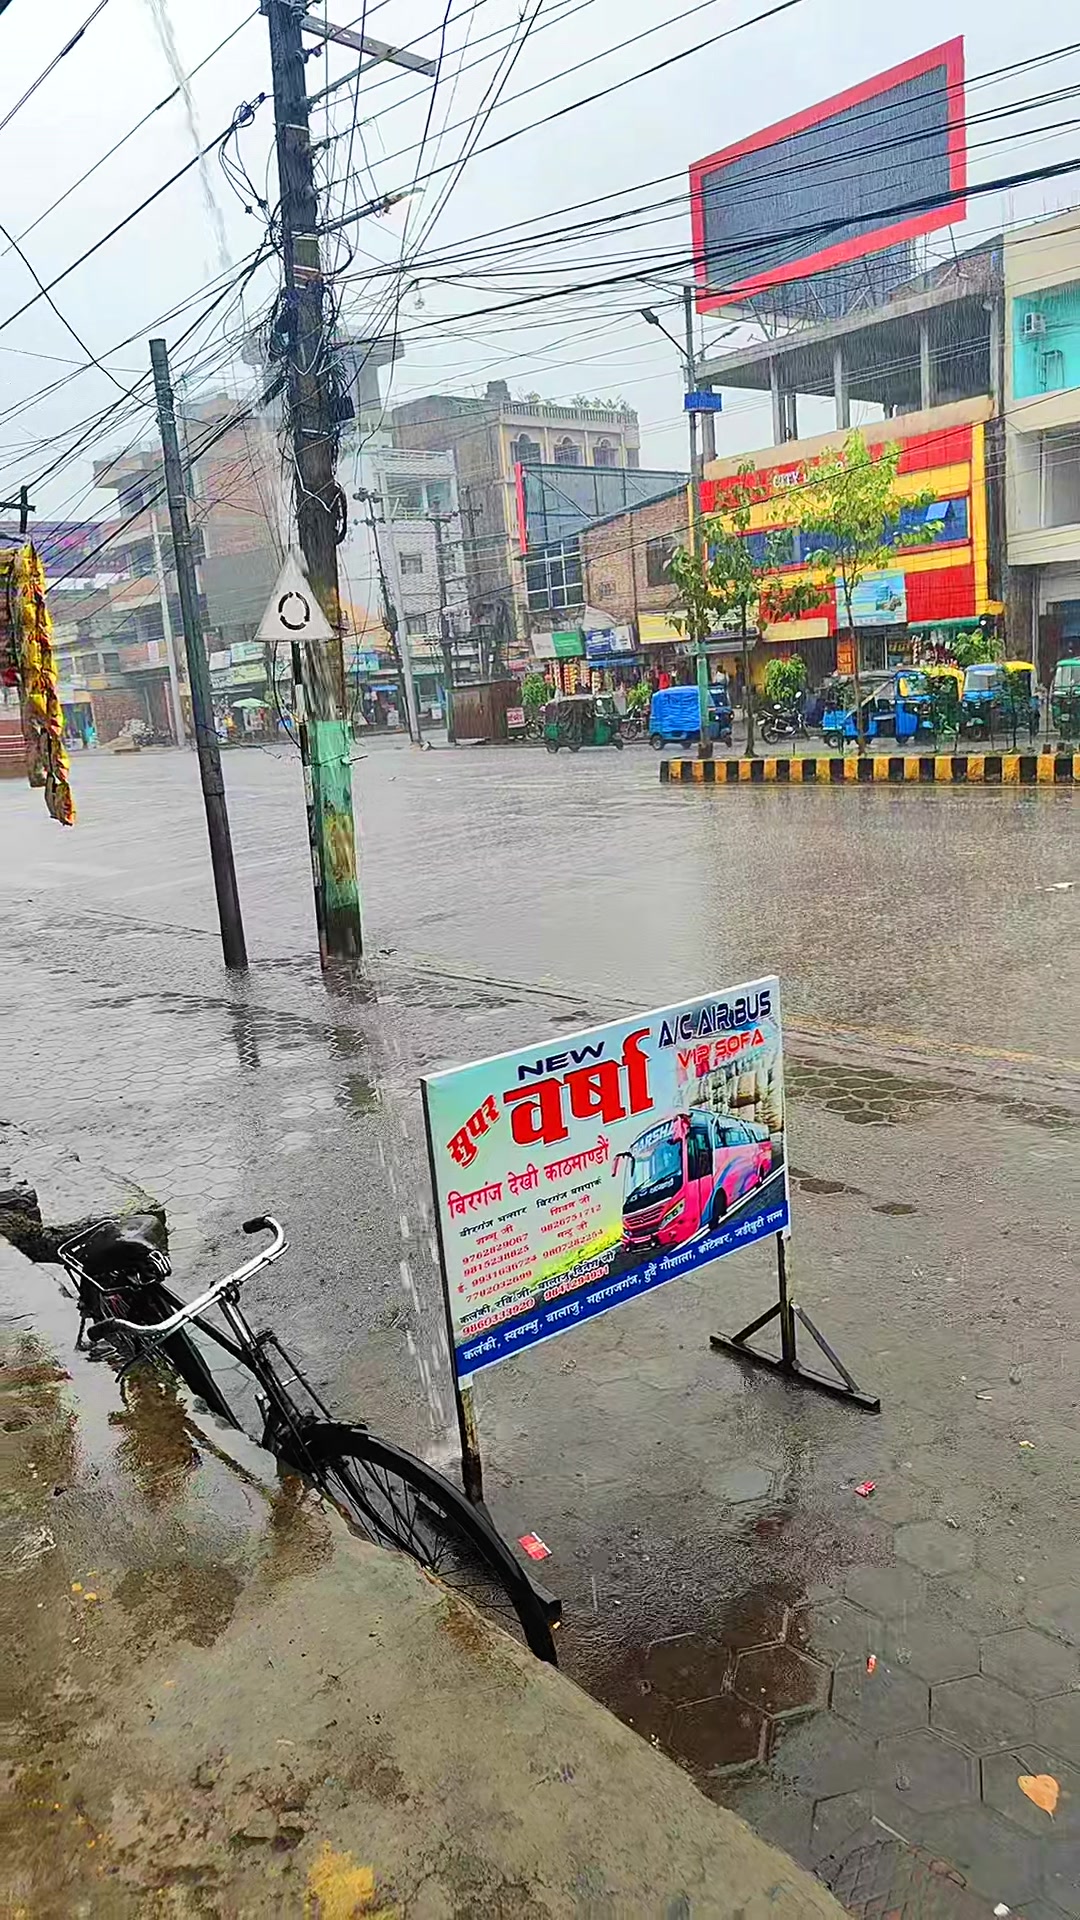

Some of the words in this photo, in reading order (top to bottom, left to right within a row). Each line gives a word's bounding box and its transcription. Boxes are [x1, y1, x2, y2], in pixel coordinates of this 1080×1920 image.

[658, 1014, 692, 1048] A/C
[698, 1003, 731, 1035] AIR
[734, 990, 771, 1026] BUS
[518, 1042, 605, 1081] NEW
[677, 1045, 710, 1069] VIP
[715, 1029, 765, 1057] SOFA
[447, 1095, 500, 1168] सुपर
[503, 1027, 654, 1145] वर्षा
[447, 1182, 502, 1218] बिरगंज
[508, 1163, 539, 1196] देखी
[462, 1298, 534, 1335] 9860333920
[463, 1337, 501, 1360] कलंकी,
[586, 1274, 641, 1304] महाराजगंज,
